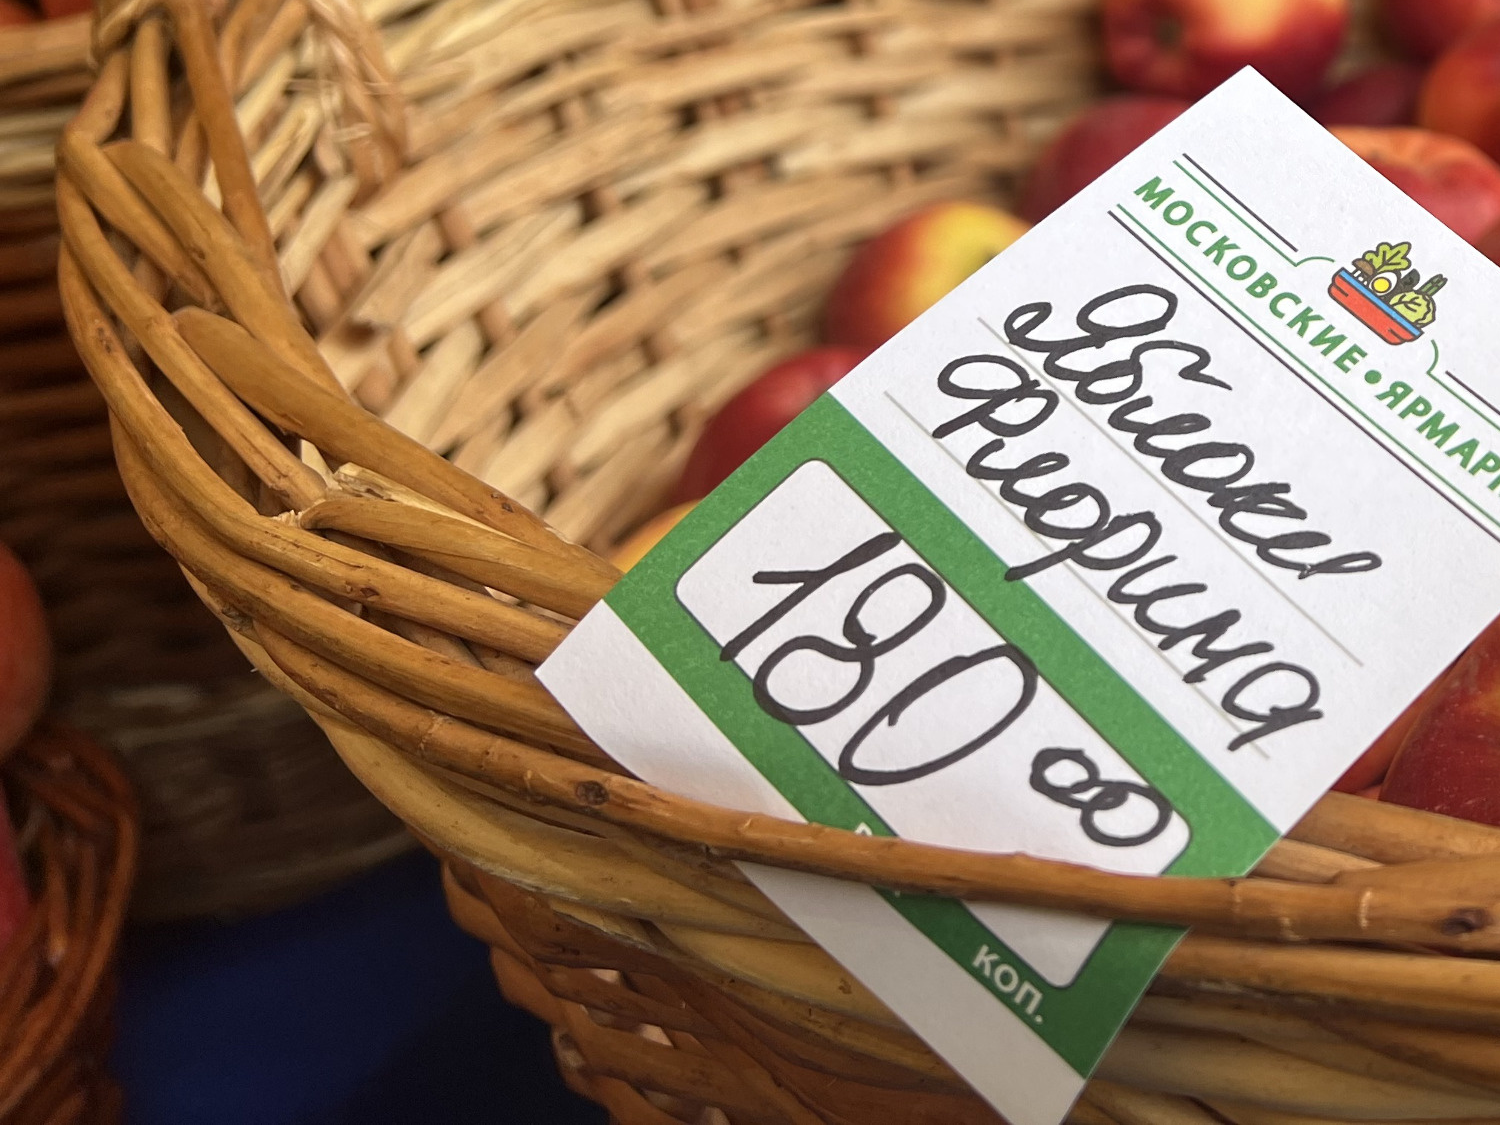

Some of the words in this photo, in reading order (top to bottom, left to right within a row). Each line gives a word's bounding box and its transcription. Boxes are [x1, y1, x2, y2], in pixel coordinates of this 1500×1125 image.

[1134, 176, 1366, 373] МОСКОВСКИЕ
[935, 353, 1323, 752] Флорина
[1003, 283, 1382, 580] Яблоки
[719, 531, 1039, 786] 180
